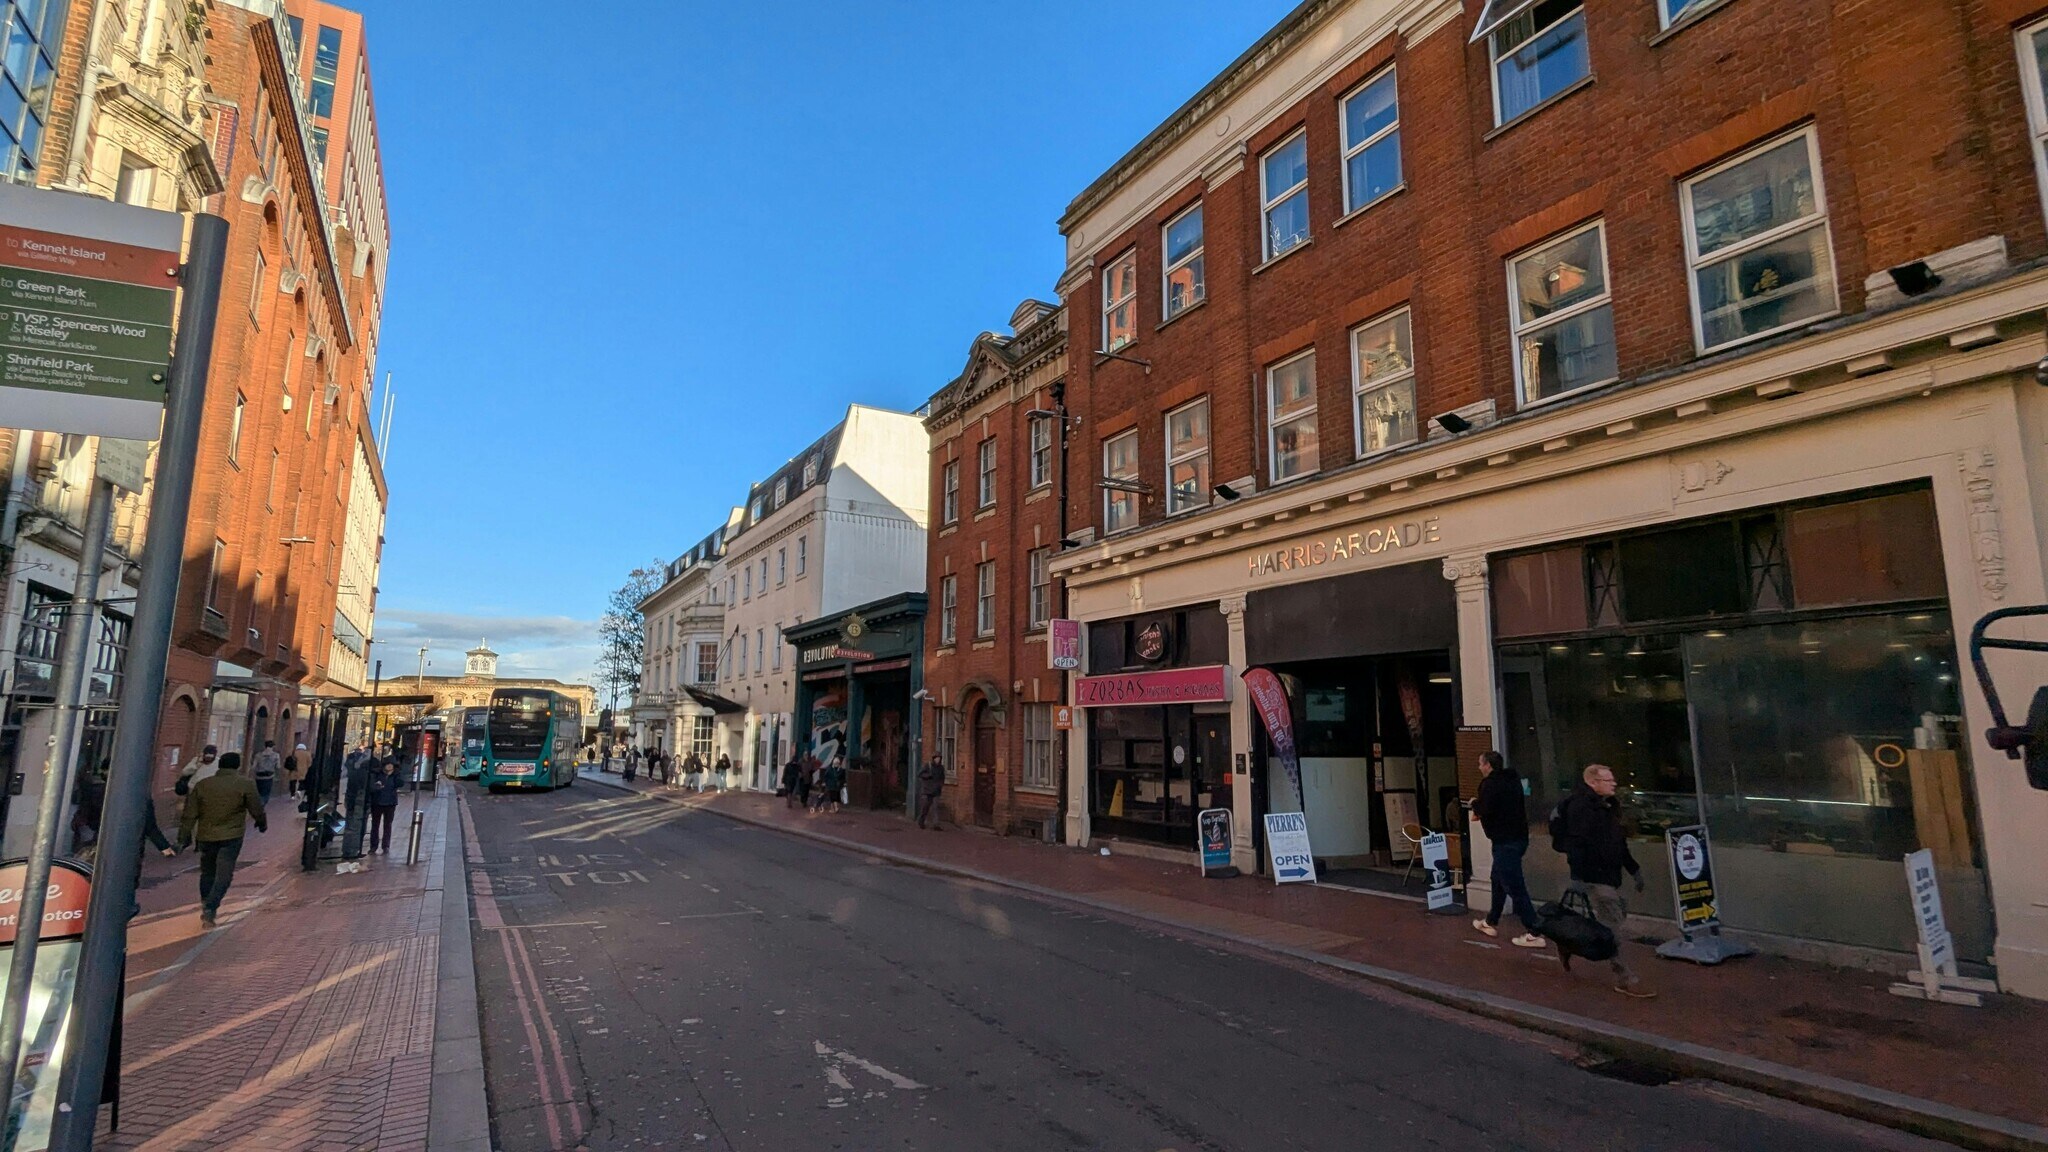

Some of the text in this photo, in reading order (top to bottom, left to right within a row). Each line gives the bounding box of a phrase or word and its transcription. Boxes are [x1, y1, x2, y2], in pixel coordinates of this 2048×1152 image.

[6, 238, 106, 260] to Kennet Island
[1, 278, 87, 298] to Green Park
[25, 292, 53, 302] Kennet
[55, 295, 77, 305] Island
[10, 323, 69, 341] & Riseley
[52, 317, 108, 332] Spencers
[111, 325, 146, 337] Wood
[7, 354, 62, 369] Shinfield
[66, 360, 94, 373] Park
[1249, 515, 1441, 577] HARRIS ARCADE
[1056, 658, 1075, 667] OPEN
[1089, 678, 1144, 701] ZORBAS
[1267, 814, 1305, 833] PIERRE'S
[1275, 854, 1310, 866] OPEN
[44, 909, 83, 921] otos
